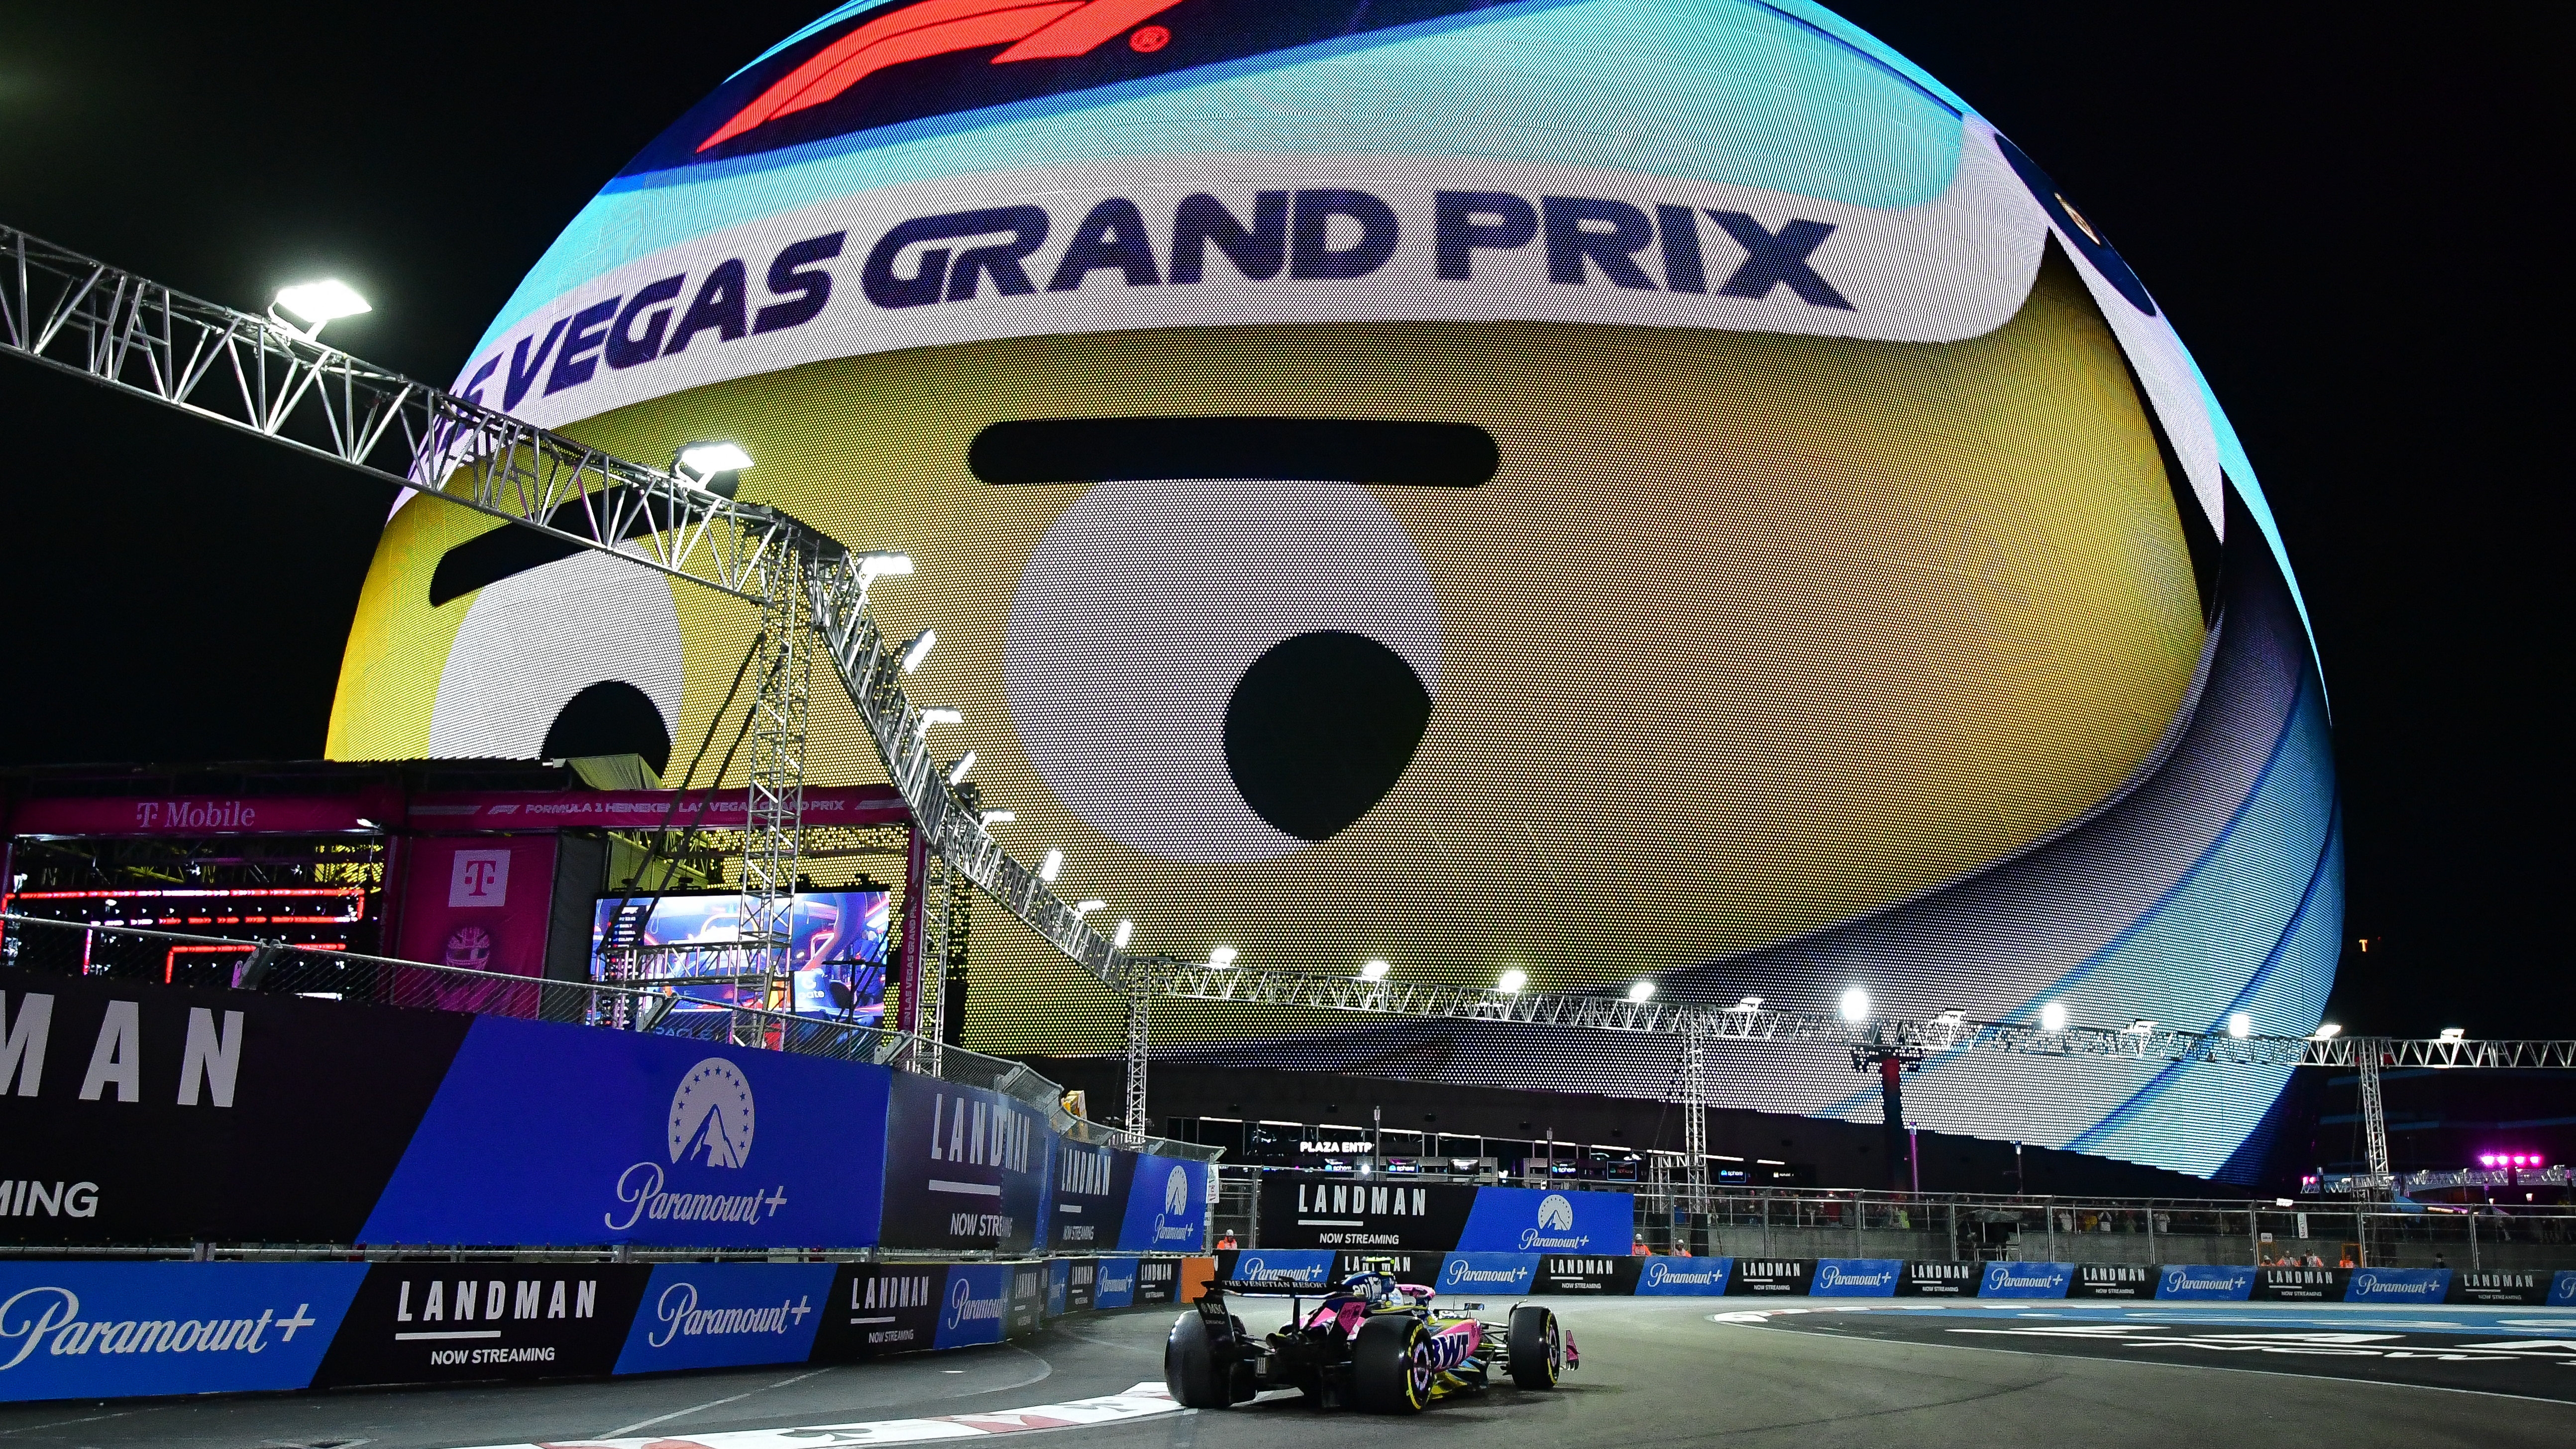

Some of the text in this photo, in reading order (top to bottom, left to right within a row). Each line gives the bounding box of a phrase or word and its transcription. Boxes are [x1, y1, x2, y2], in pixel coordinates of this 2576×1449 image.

[503, 231, 847, 413] VEGAS
[862, 188, 1400, 310] GRAND
[1434, 191, 1859, 312] PRIX
[164, 801, 255, 827] Mobile
[526, 803, 592, 814] FORMULA
[605, 802, 671, 813] HEINEKE
[811, 800, 845, 810] PRIX
[905, 955, 914, 989] VEGAS
[1300, 1142, 1339, 1152] PLAZA
[605, 1162, 787, 1230] Paramount+
[1298, 1184, 1425, 1216] LANDMAN
[950, 1213, 978, 1235] NOW
[1319, 1233, 1399, 1244] NOW STREAMING
[1519, 1228, 1590, 1250] Paramount+
[1447, 1259, 1527, 1285] Paramount+
[1550, 1259, 1613, 1274] LANDMAN
[1648, 1263, 1722, 1287] Paramount+
[1743, 1262, 1800, 1276] LANDMAN
[1820, 1265, 1891, 1289] Paramount+
[1912, 1264, 1968, 1279] LANDMAN
[2083, 1267, 2145, 1281] LANDMAN
[2267, 1270, 2333, 1284] LANDMAN
[1989, 1268, 2063, 1290] Paramount+
[2166, 1270, 2246, 1292] Paramount+
[2356, 1274, 2440, 1295] Paramount+
[2464, 1274, 2533, 1287] LANDMAN
[398, 1280, 596, 1321] LANDMAN
[852, 1276, 929, 1309] LANDMAN
[649, 1283, 811, 1347] Paramount+
[0, 1287, 315, 1370] Paramount+
[868, 1329, 914, 1343] NOW STREAMING
[431, 1347, 555, 1365] NOW STREAMING
[1431, 1332, 1470, 1369] BWT
